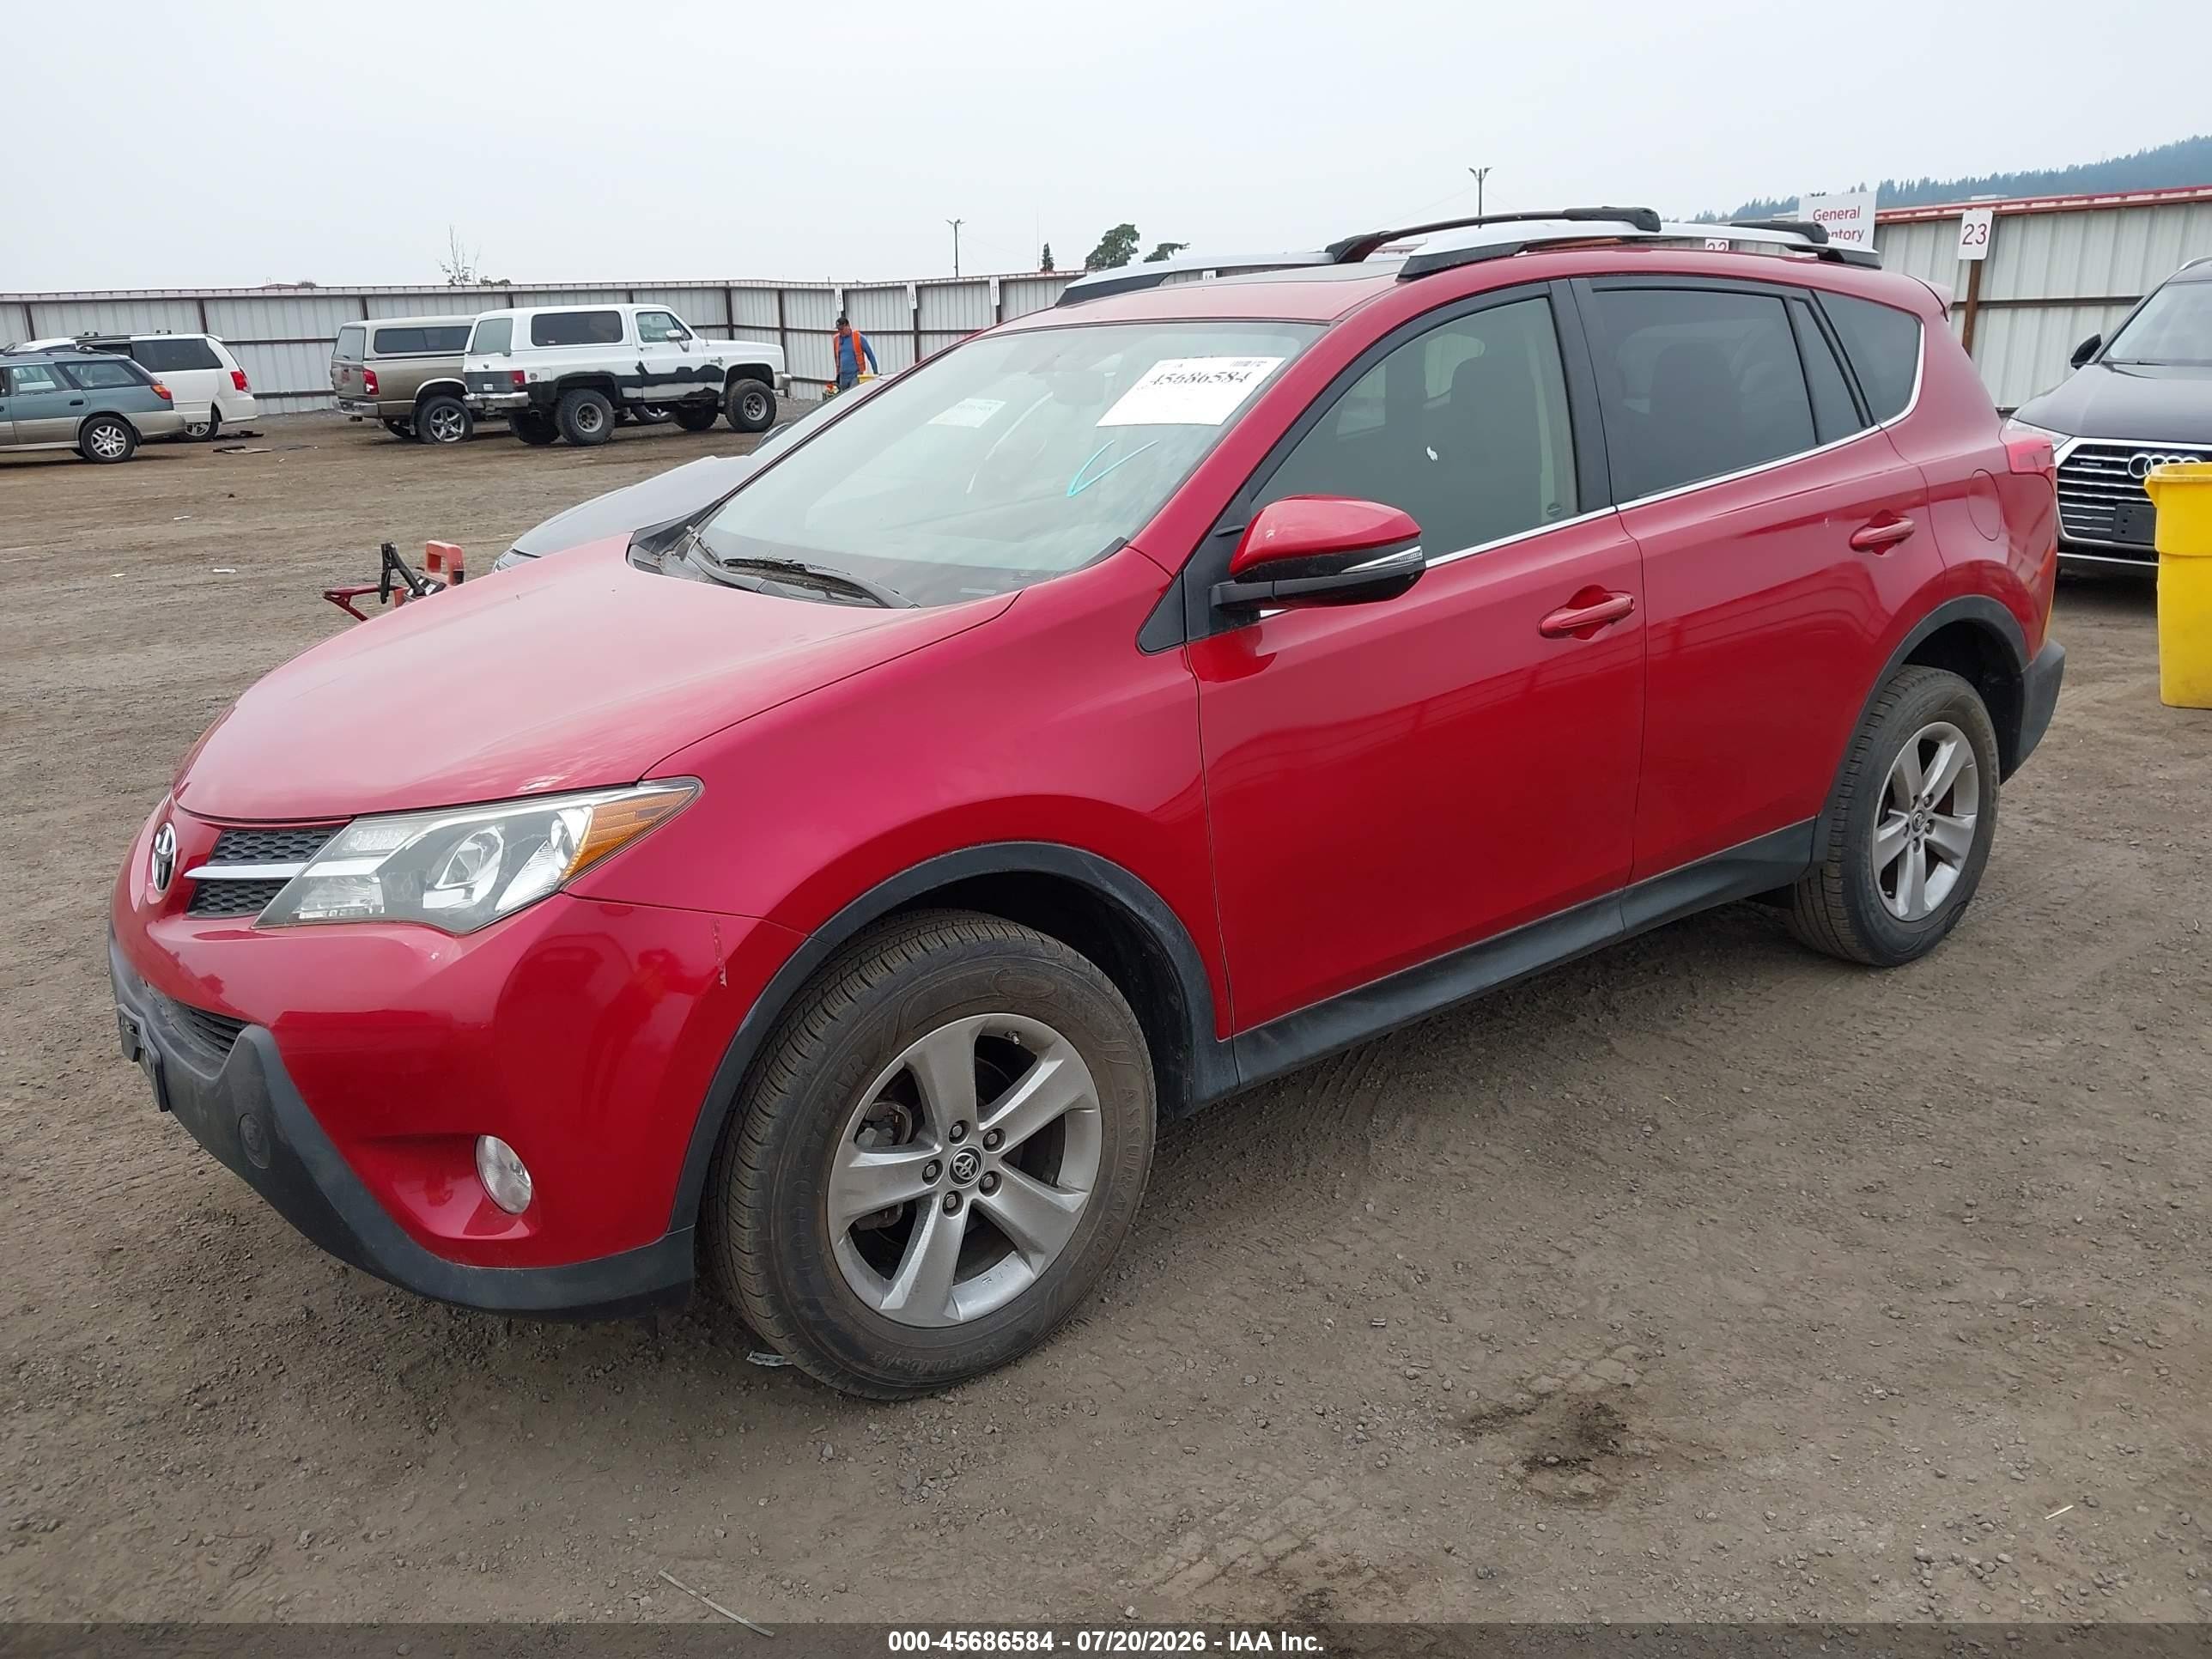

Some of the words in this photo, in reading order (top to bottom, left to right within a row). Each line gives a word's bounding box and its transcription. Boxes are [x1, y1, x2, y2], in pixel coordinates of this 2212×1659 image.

[1813, 205, 1861, 222] General
[1827, 228, 1864, 242] ntory
[1961, 223, 1987, 245] 23
